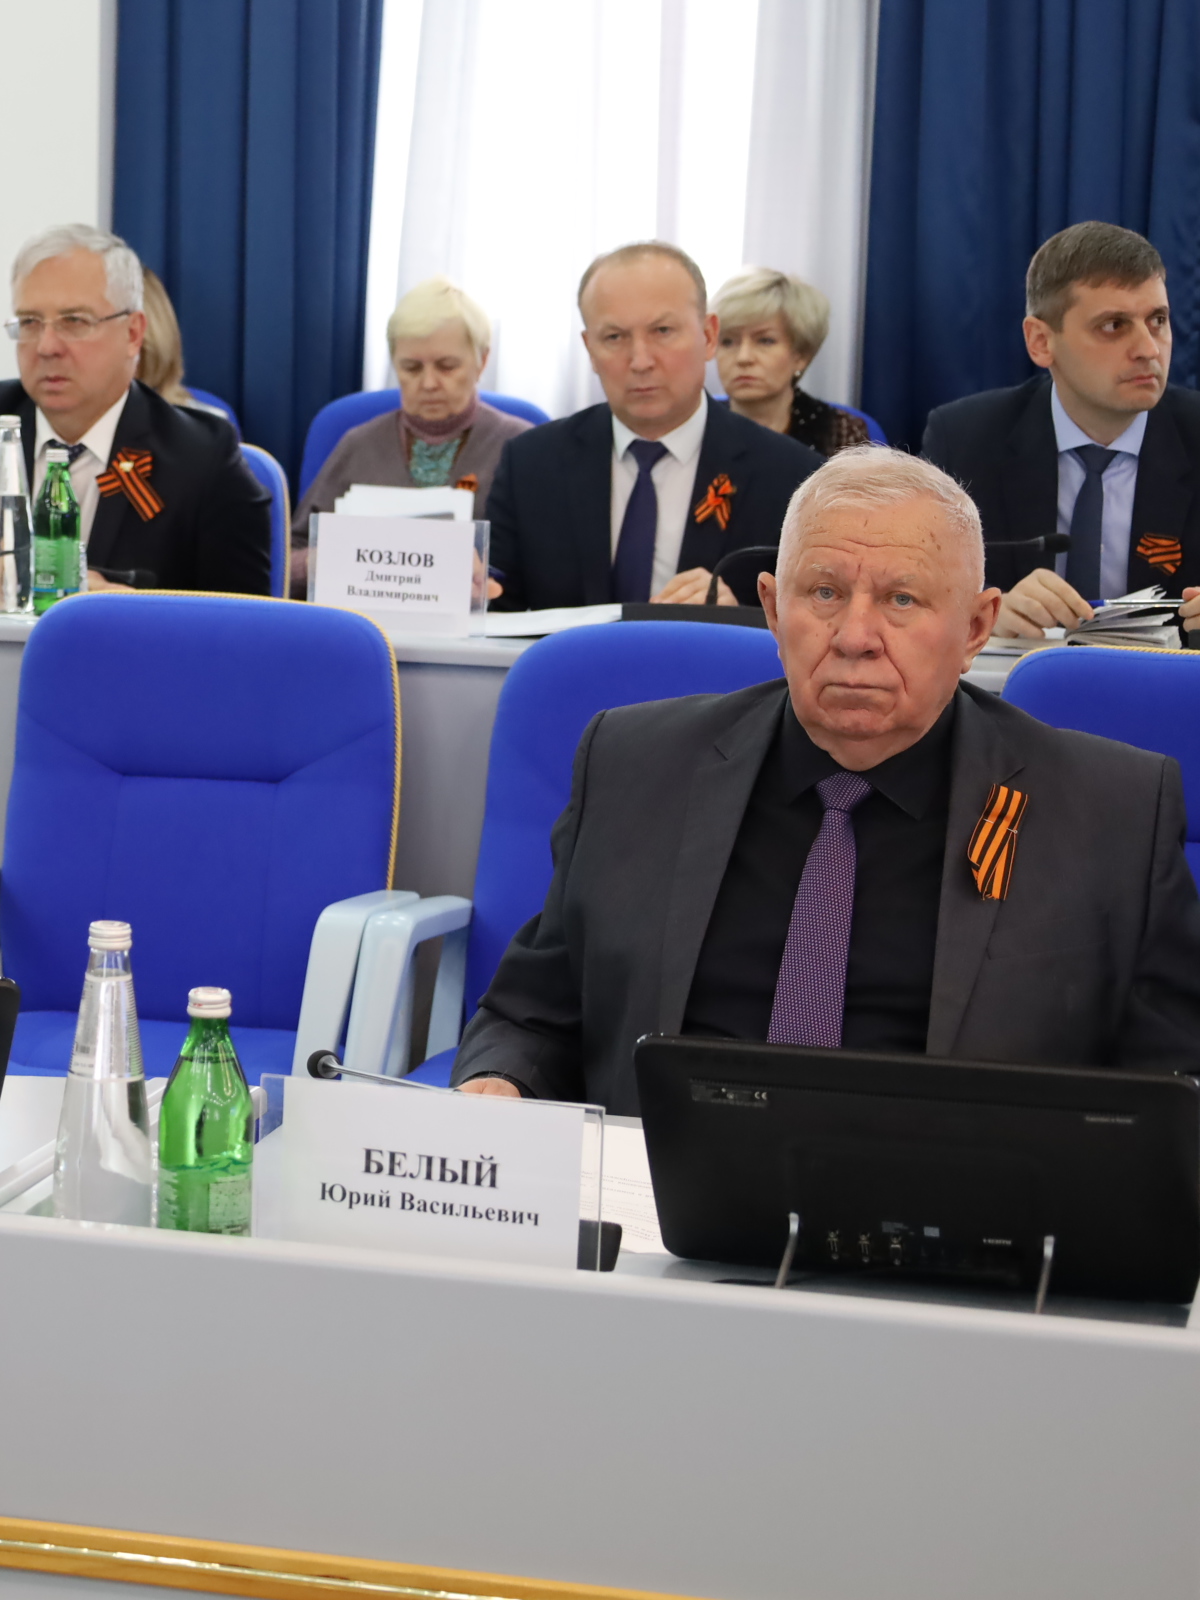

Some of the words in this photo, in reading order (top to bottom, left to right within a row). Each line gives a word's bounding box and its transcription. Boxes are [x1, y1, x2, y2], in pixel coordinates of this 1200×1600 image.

[356, 549, 434, 567] КОЗЛОВ
[365, 571, 421, 585] Дмитрий
[347, 585, 438, 601] Владимирович
[362, 1148, 498, 1189] БЕЛЫЙ
[320, 1182, 391, 1211] Юрий
[399, 1191, 539, 1226] Васильевич
